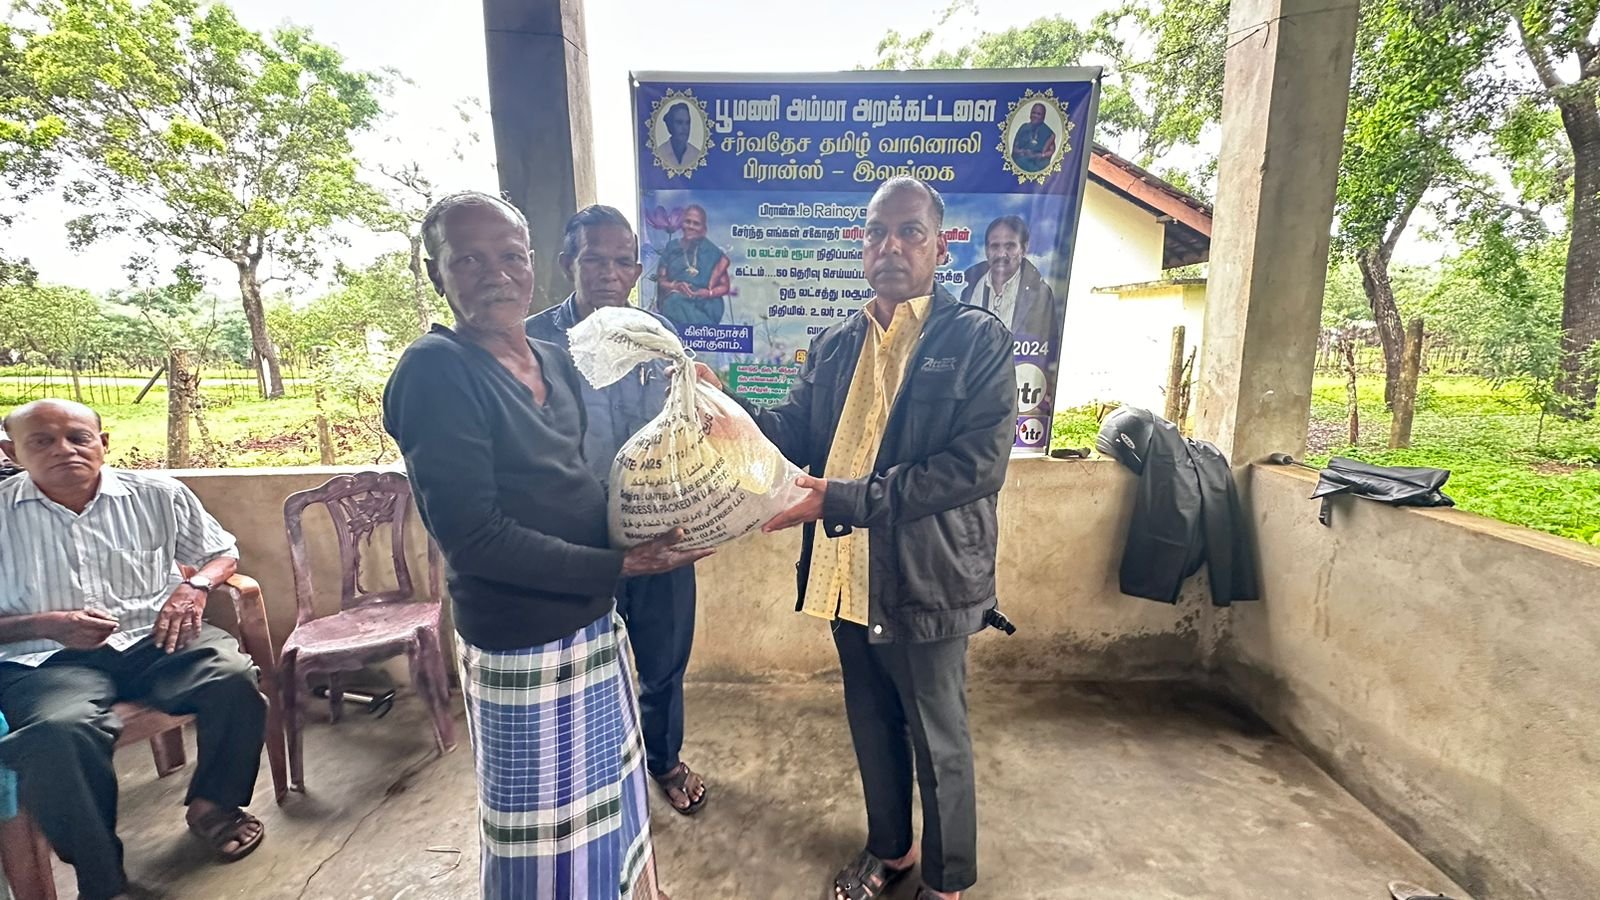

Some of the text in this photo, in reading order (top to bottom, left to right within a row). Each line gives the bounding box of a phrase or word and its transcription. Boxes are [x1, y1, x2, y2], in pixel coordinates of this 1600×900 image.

[715, 94, 997, 133] பூமணி அம்மா அறக்கட்டளை
[720, 130, 982, 158] சர்வதேச தமிழ் வானொலி
[743, 157, 824, 183] பிரான்ஸ்
[814, 203, 858, 219] Raincy
[732, 226, 764, 240] சேர்ந்த
[766, 227, 800, 239] எங்கள்
[747, 248, 757, 258] 10
[759, 247, 789, 259] லட்சம்
[790, 267, 820, 281] தெரிவு
[822, 268, 865, 279] செய்யப்ப
[779, 287, 797, 301] ஒரு
[684, 325, 749, 341] கிளிநொச்சி
[1013, 341, 1048, 356] 2024
